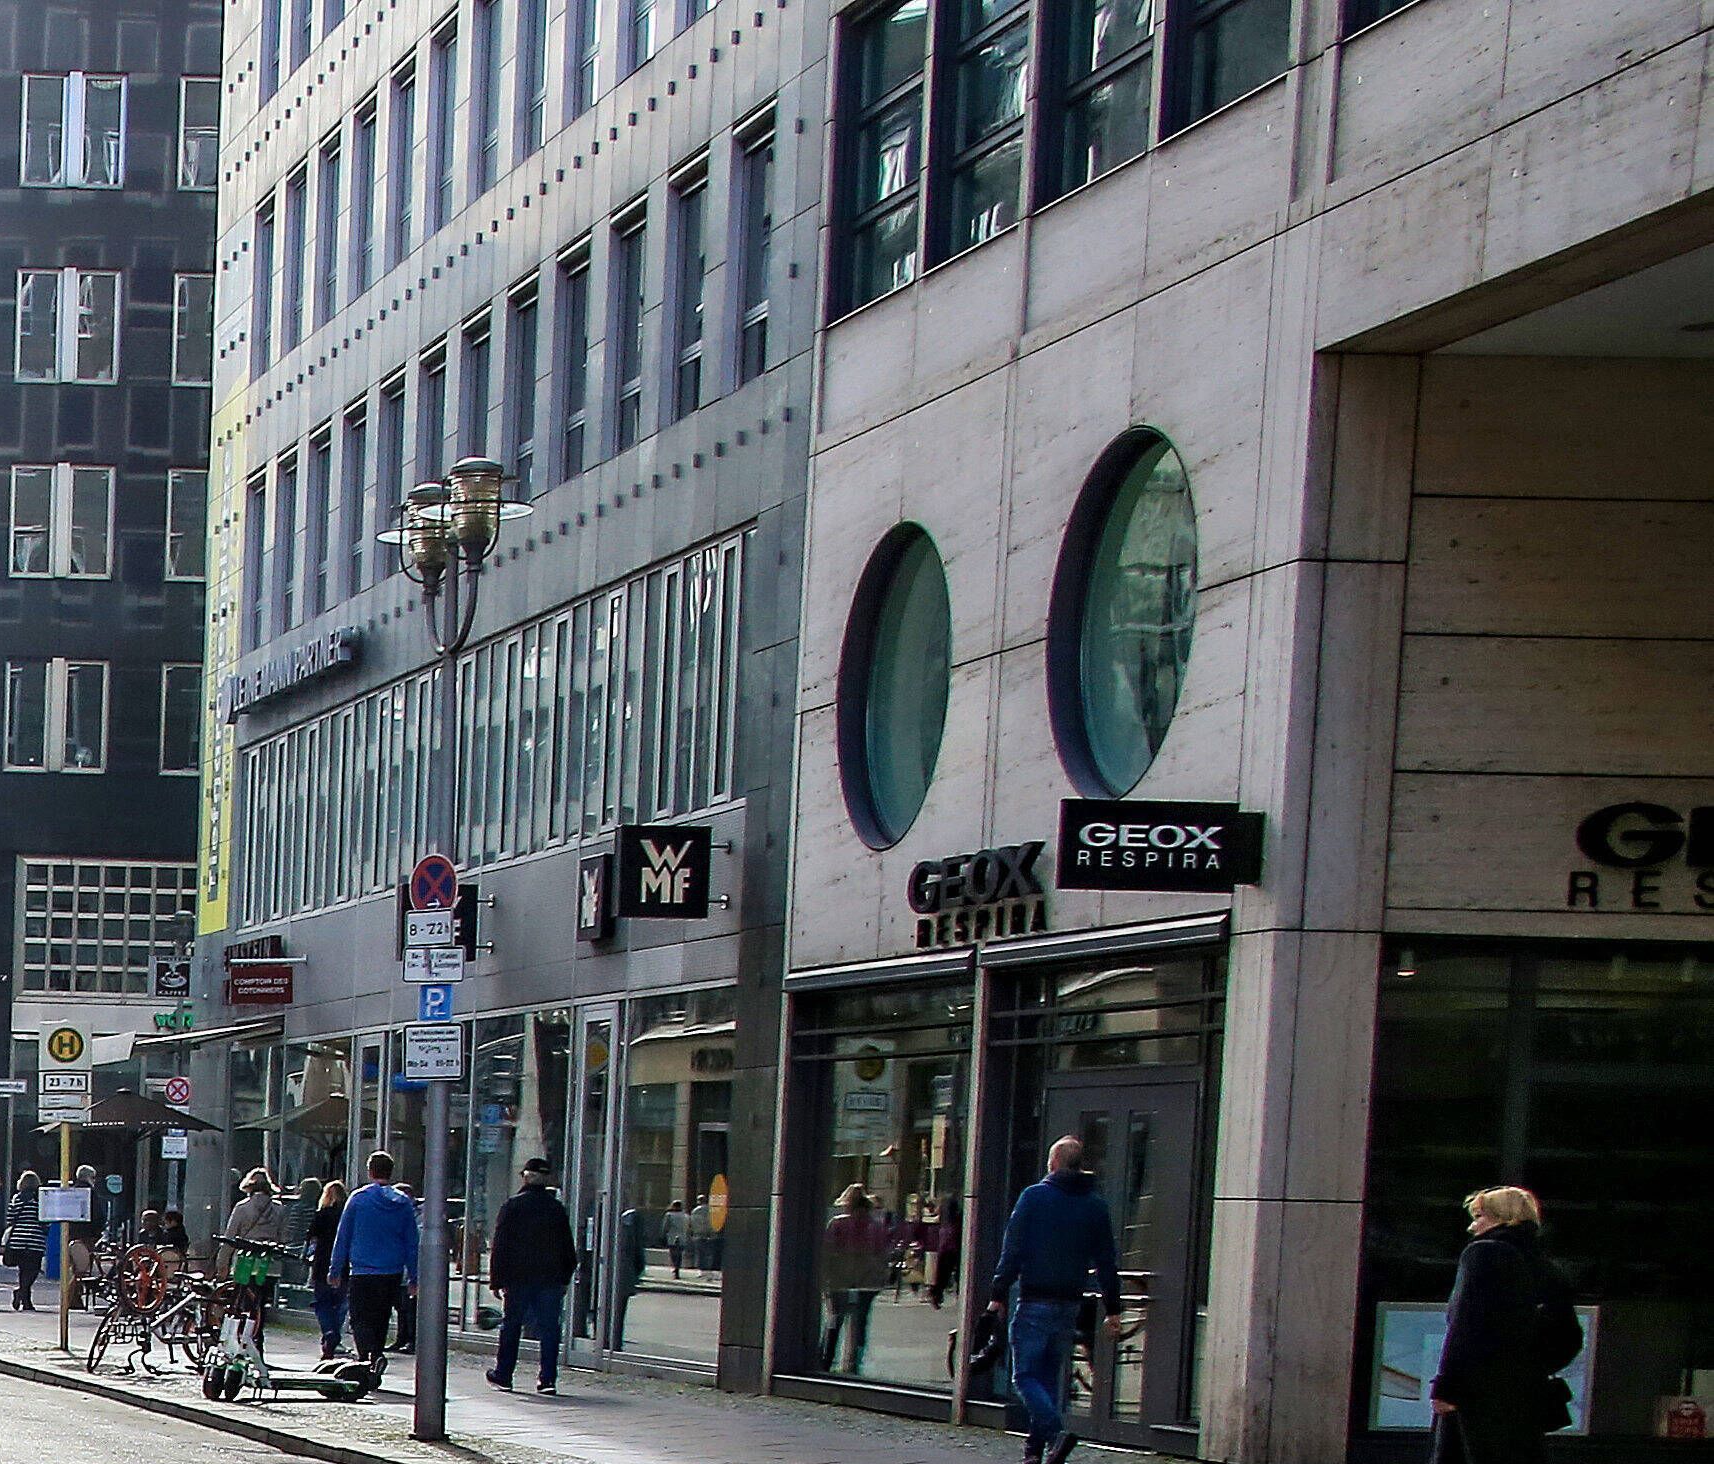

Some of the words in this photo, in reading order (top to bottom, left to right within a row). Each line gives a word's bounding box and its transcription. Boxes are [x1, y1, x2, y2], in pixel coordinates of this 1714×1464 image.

[1079, 822, 1222, 849] GEOX
[1077, 850, 1221, 870] RESPIRA
[907, 840, 1047, 914] GEOX
[409, 923, 418, 936] 8
[915, 899, 1048, 949] RESPIRA
[426, 988, 444, 1017] P
[59, 1035, 73, 1054] H
[49, 1077, 60, 1086] 23
[69, 1077, 75, 1086] 7
